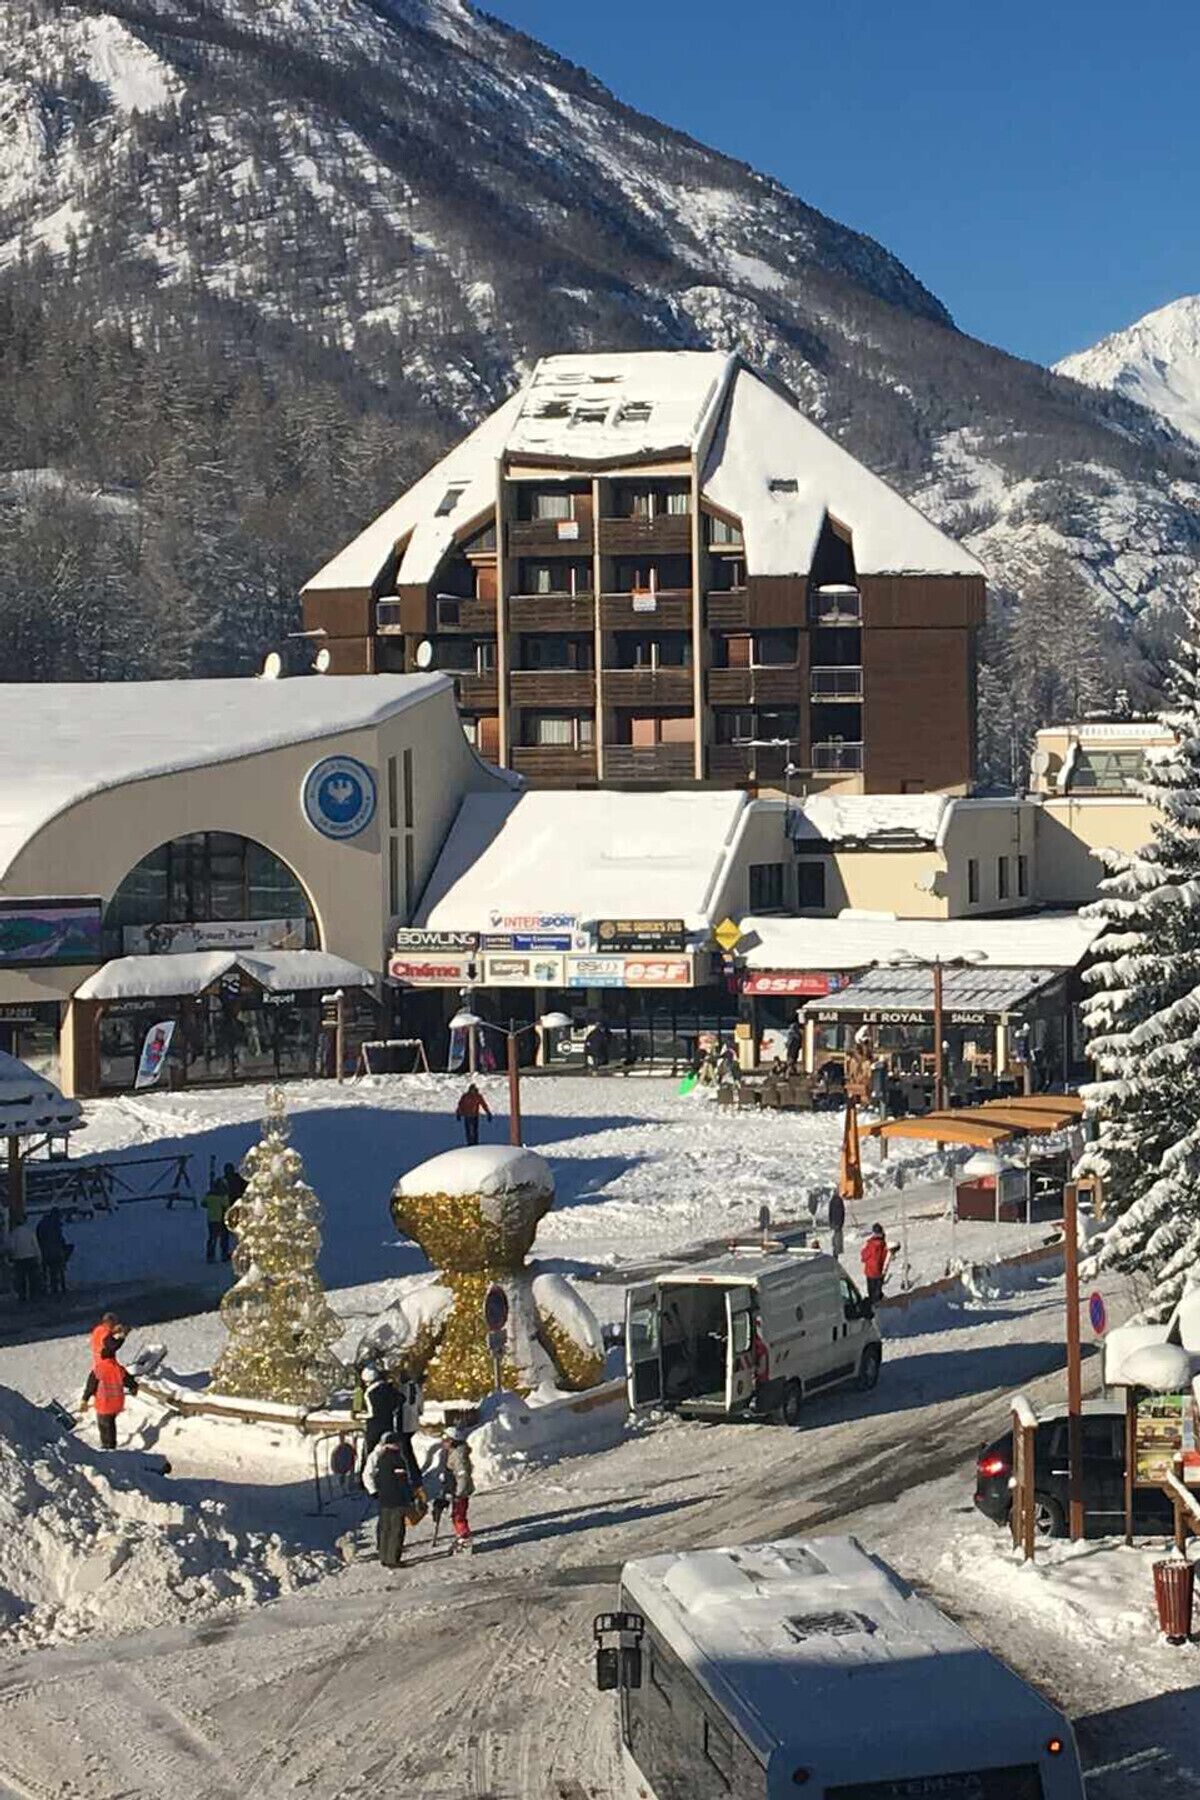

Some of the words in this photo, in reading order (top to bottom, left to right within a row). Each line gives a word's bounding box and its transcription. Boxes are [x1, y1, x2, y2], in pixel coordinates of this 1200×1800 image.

[504, 916, 576, 928] INTERSPORT
[397, 932, 475, 945] BOWLING
[392, 962, 461, 978] Cinéma
[818, 1012, 838, 1021] BAR
[862, 1012, 877, 1022] LE
[881, 1012, 925, 1023] ROYAL
[951, 1013, 985, 1023] SNACK
